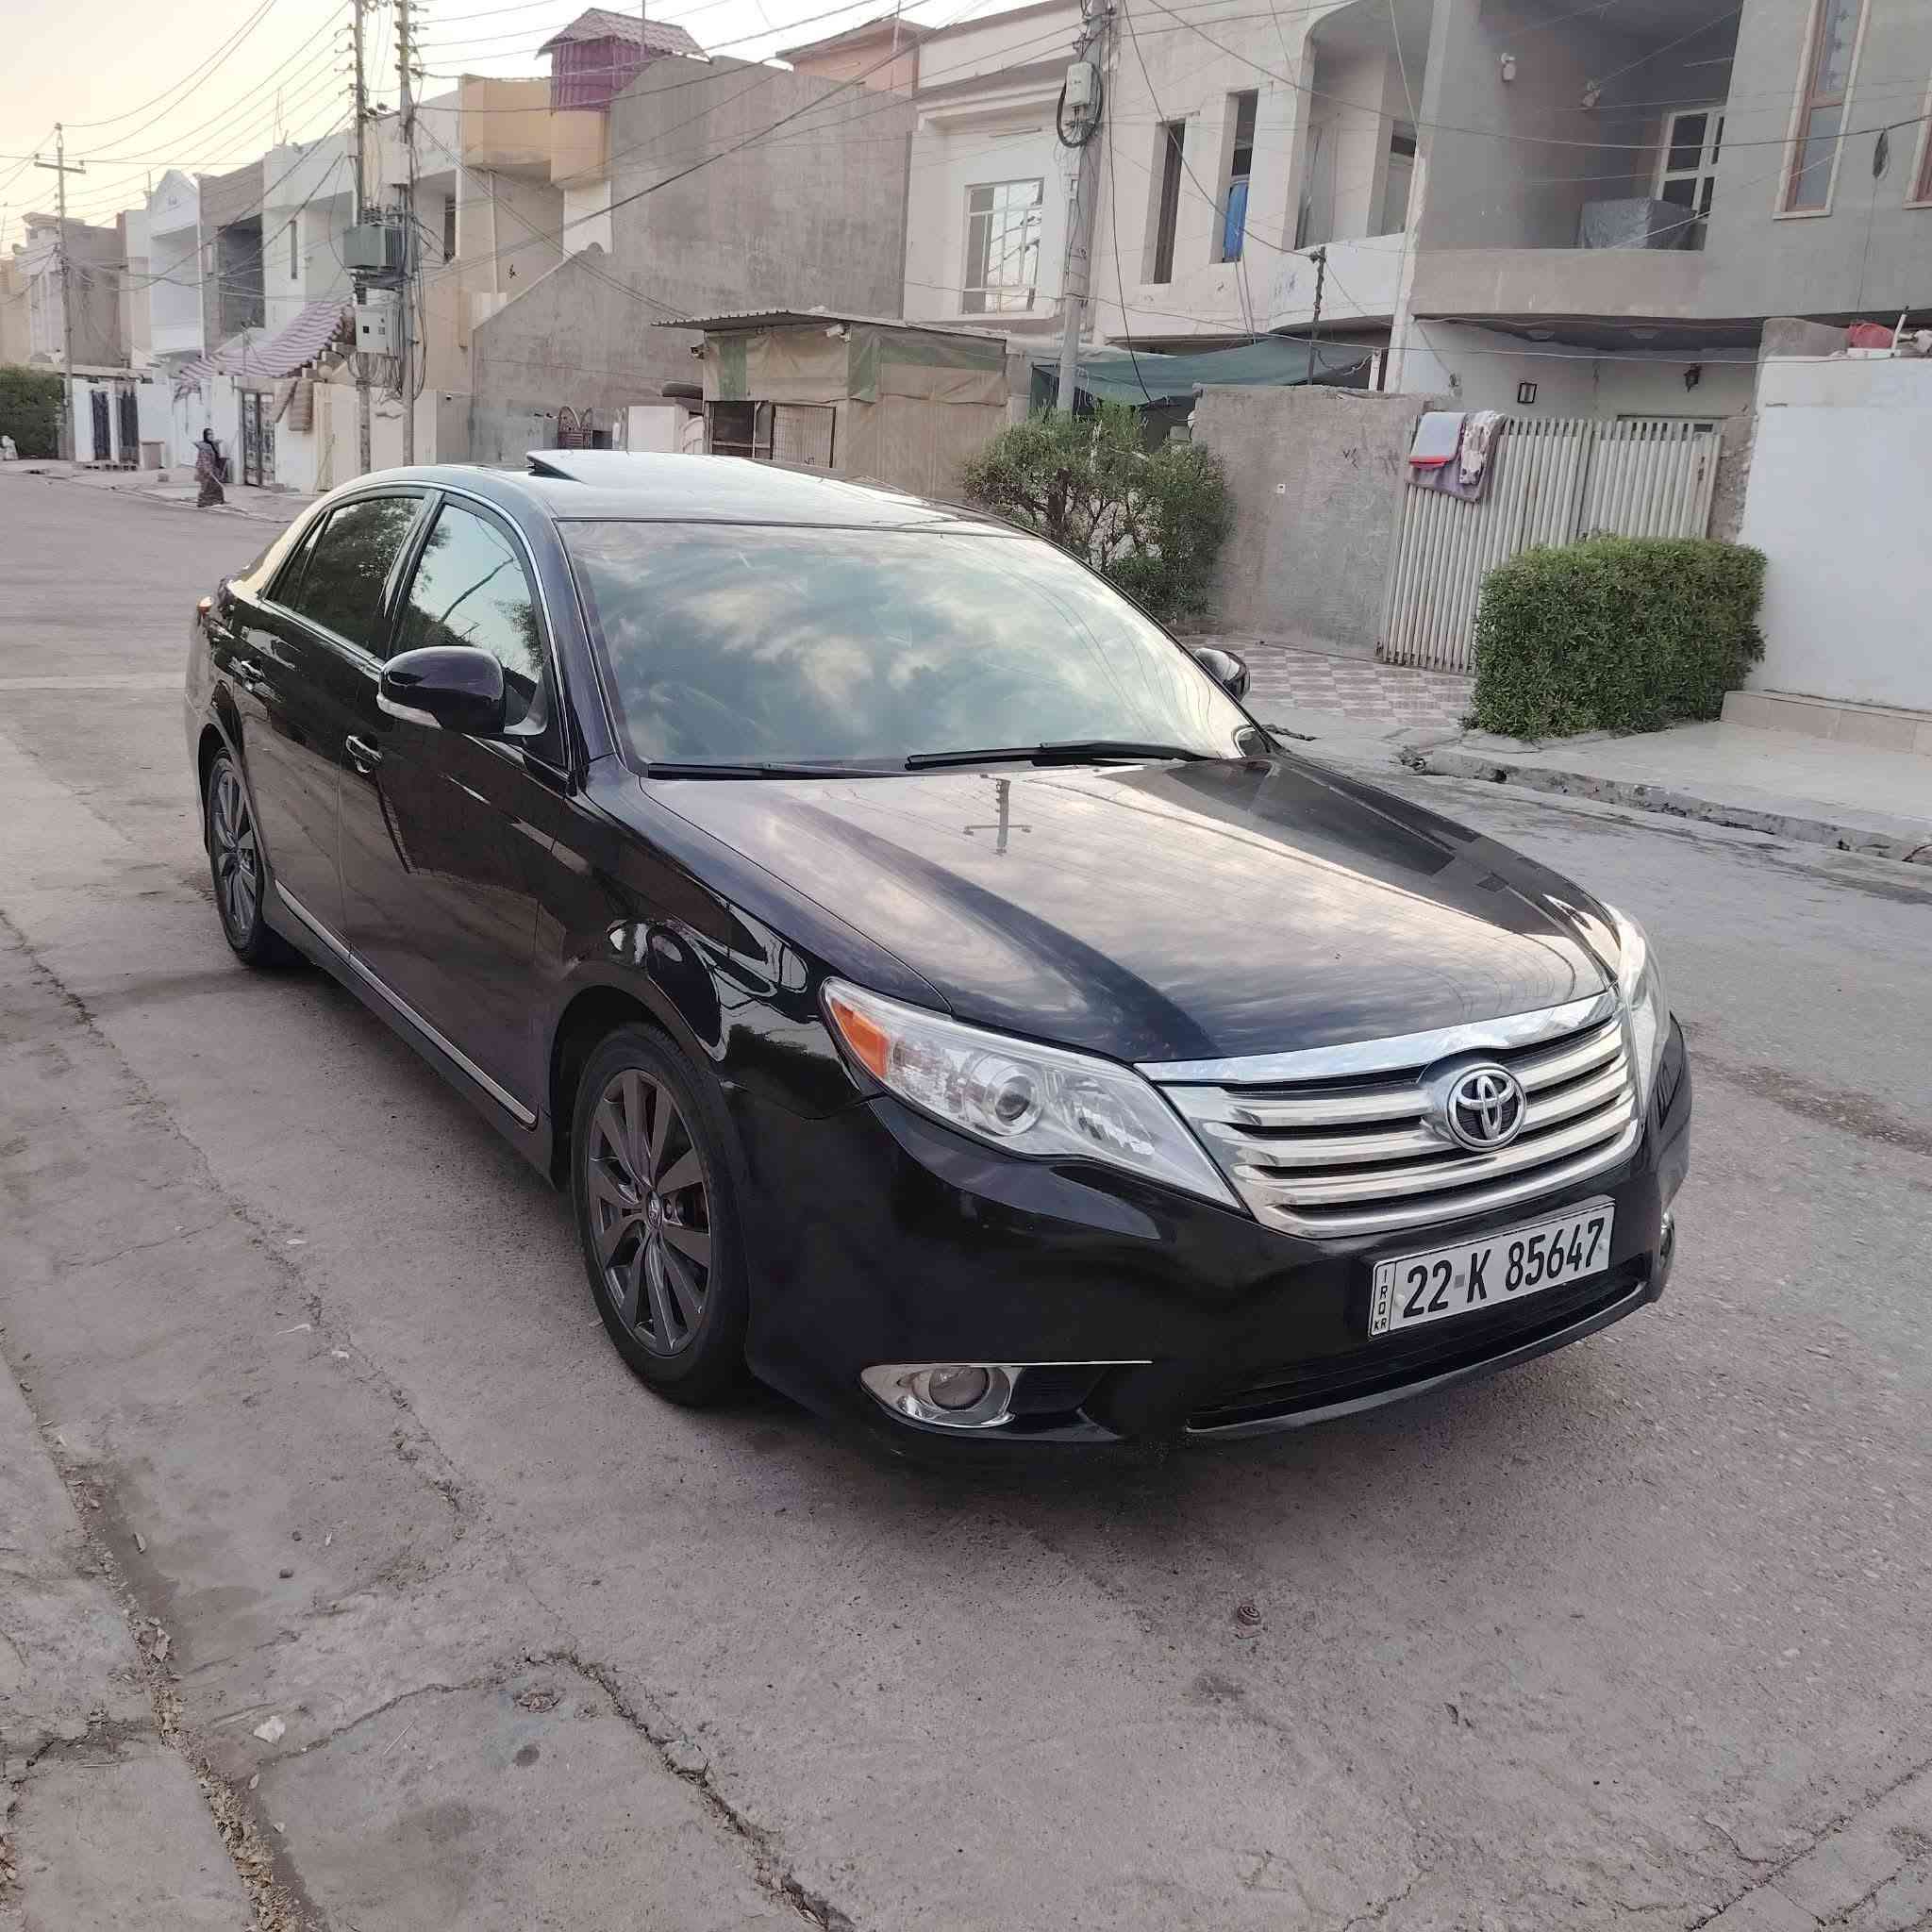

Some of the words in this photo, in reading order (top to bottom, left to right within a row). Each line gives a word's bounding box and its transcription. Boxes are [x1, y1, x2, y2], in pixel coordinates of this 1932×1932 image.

[1403, 1259, 1452, 1318] 22
[1467, 1249, 1491, 1303] K
[1505, 1217, 1605, 1291] 85647
[1374, 1318, 1387, 1331] KR
